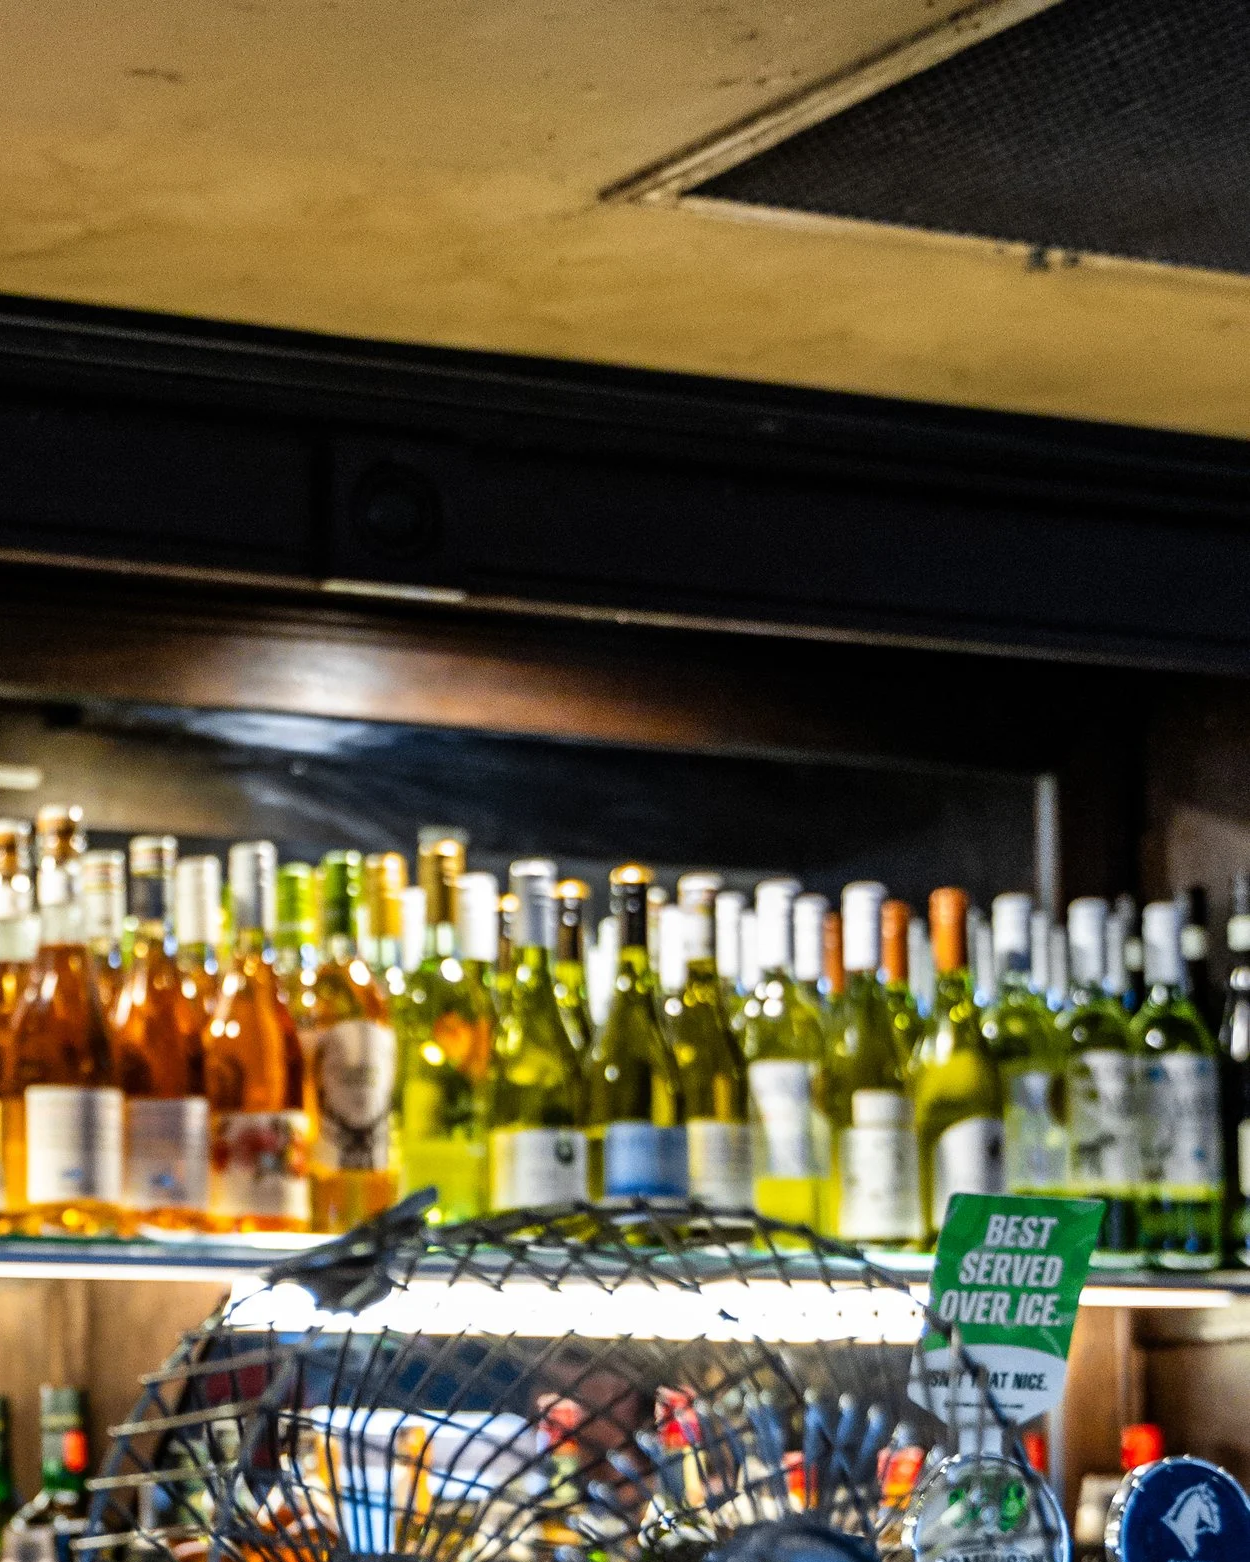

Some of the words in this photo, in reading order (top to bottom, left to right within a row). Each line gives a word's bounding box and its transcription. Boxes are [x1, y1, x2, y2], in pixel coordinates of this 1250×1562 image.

[984, 1213, 1060, 1249] BEST
[958, 1250, 1064, 1289] SERVED
[938, 1289, 1011, 1326] OVER
[1015, 1293, 1062, 1327] ICE.
[1012, 1372, 1048, 1391] NICE.
